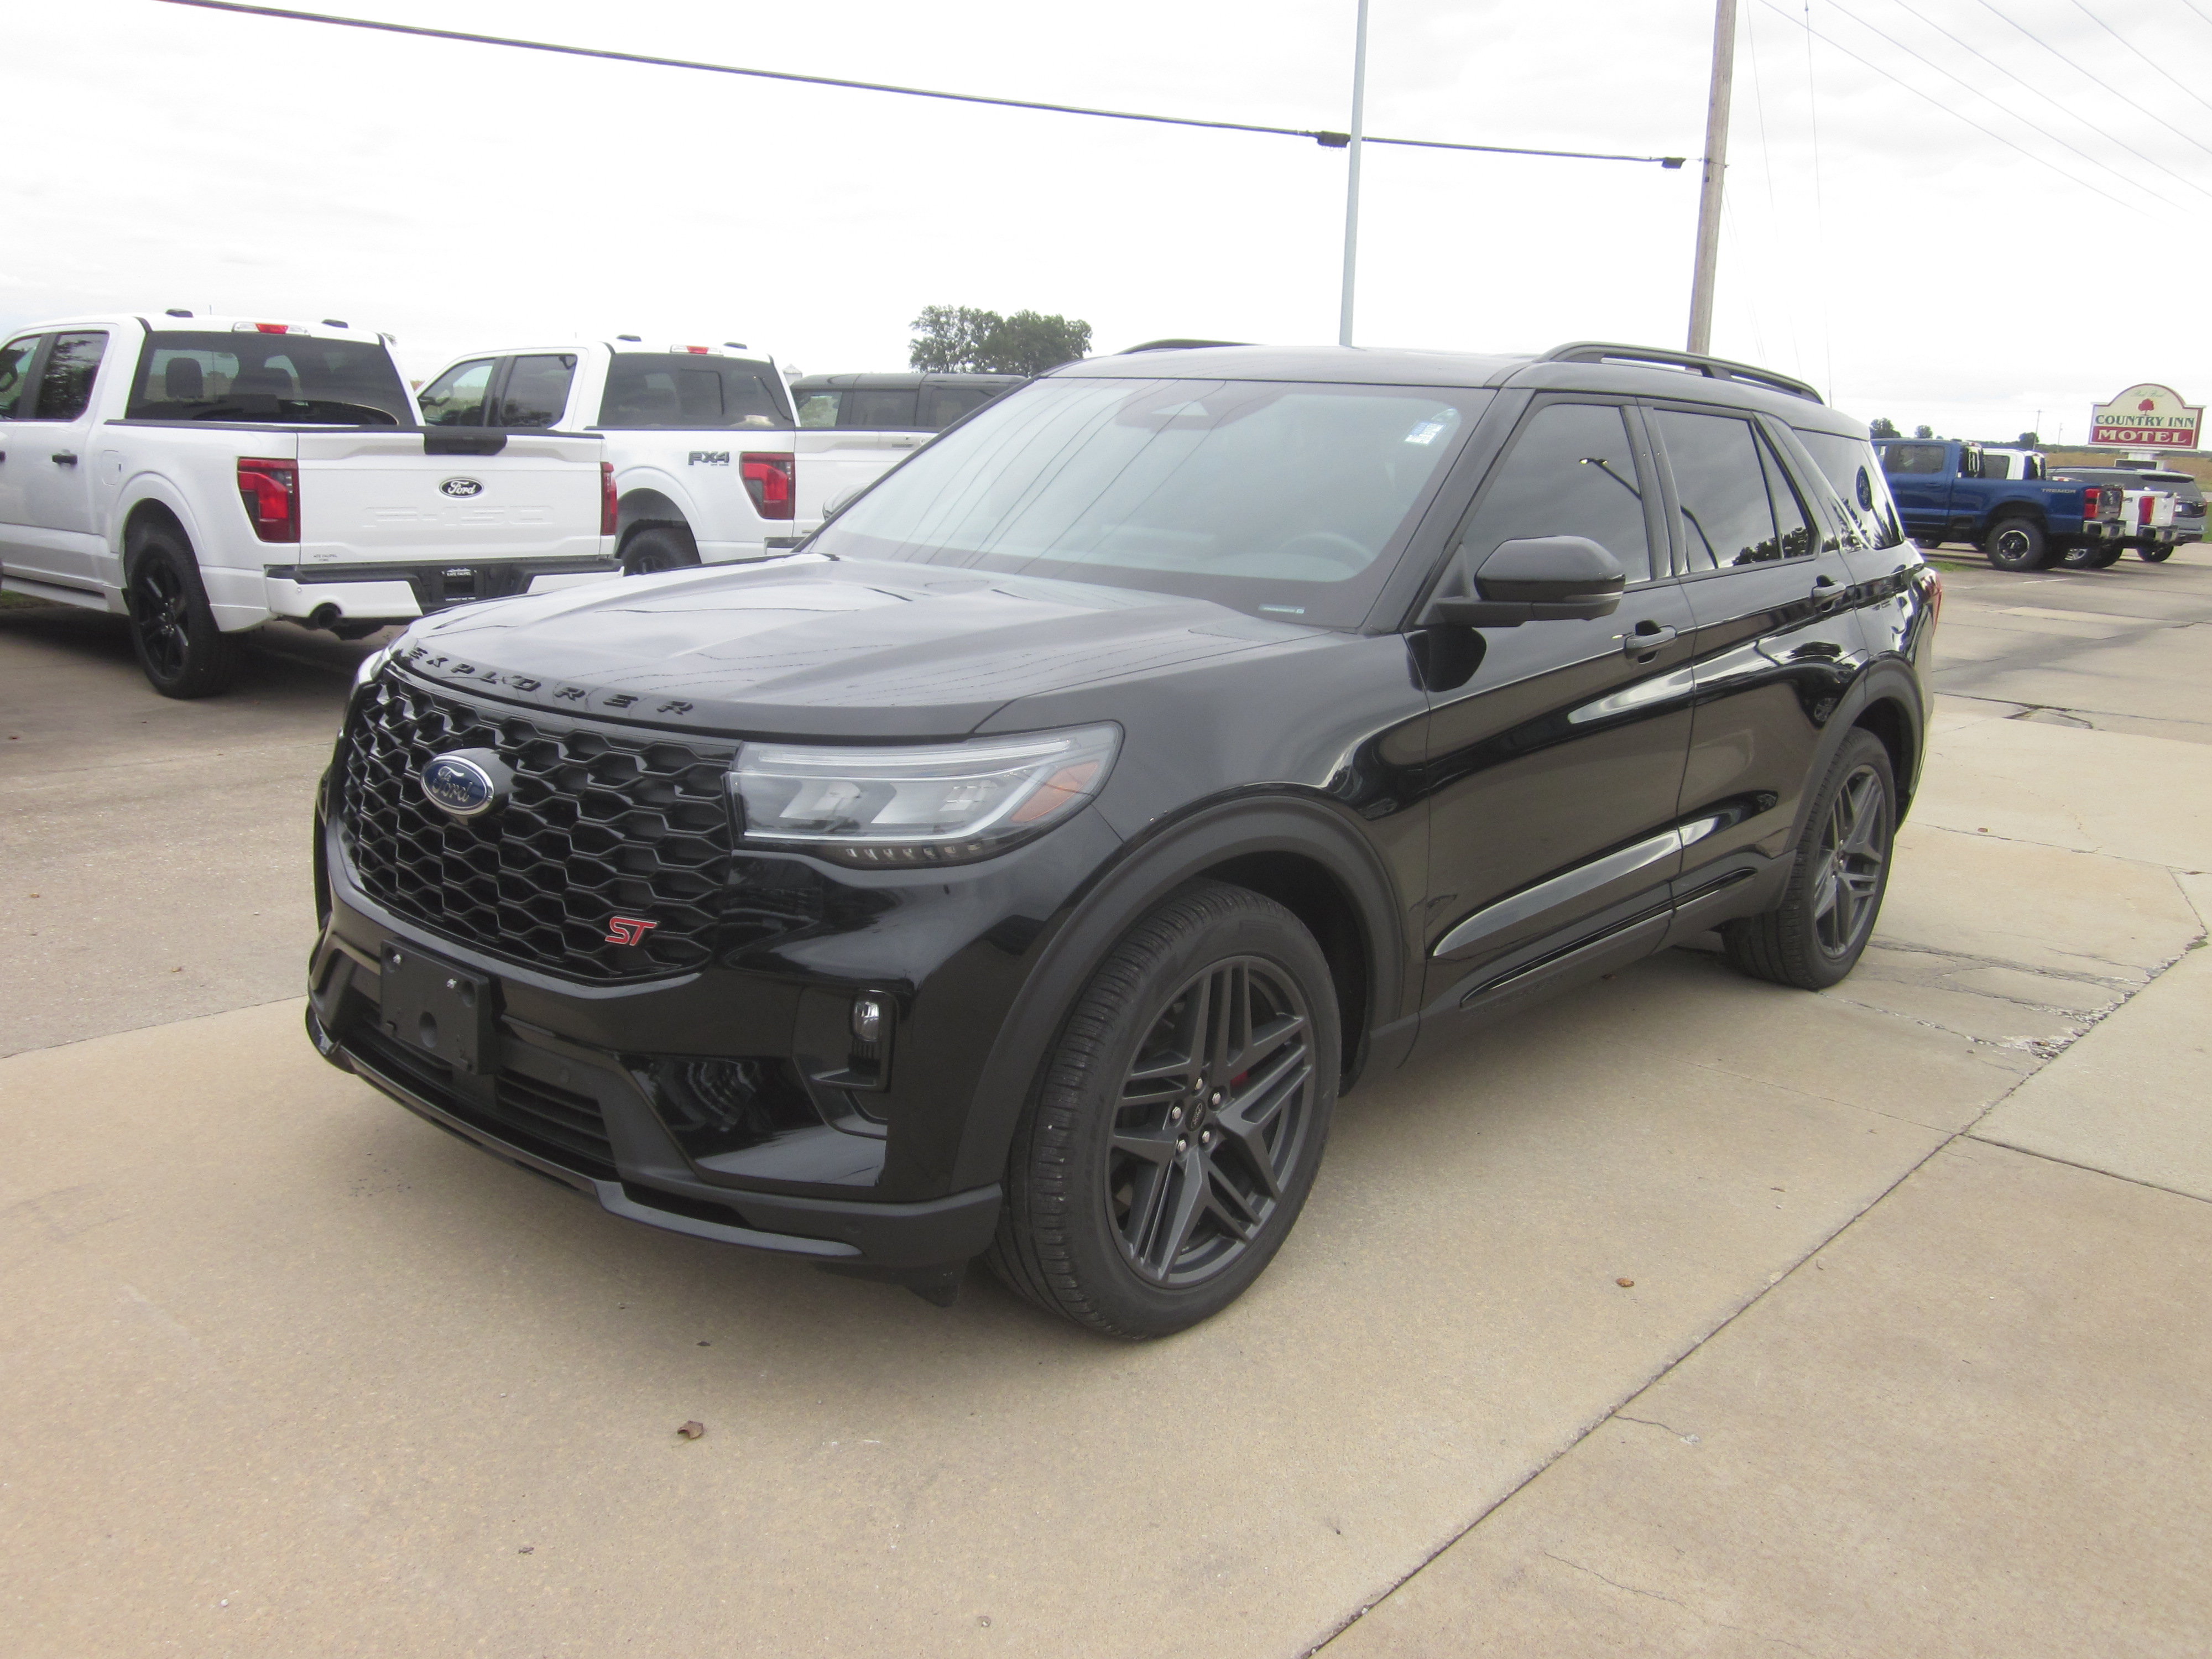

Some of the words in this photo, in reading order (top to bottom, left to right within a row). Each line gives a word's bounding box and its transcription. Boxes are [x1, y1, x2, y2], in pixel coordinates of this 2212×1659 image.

[2095, 415, 2164, 427] COUNTRY
[2168, 417, 2195, 428] INN
[2098, 429, 2187, 443] MOTEL
[688, 451, 730, 466] FX4
[447, 480, 476, 494] Ford
[362, 505, 554, 528] F-150
[409, 646, 694, 716] EXPLORER
[432, 765, 473, 802] Ford
[604, 916, 658, 946] ST
